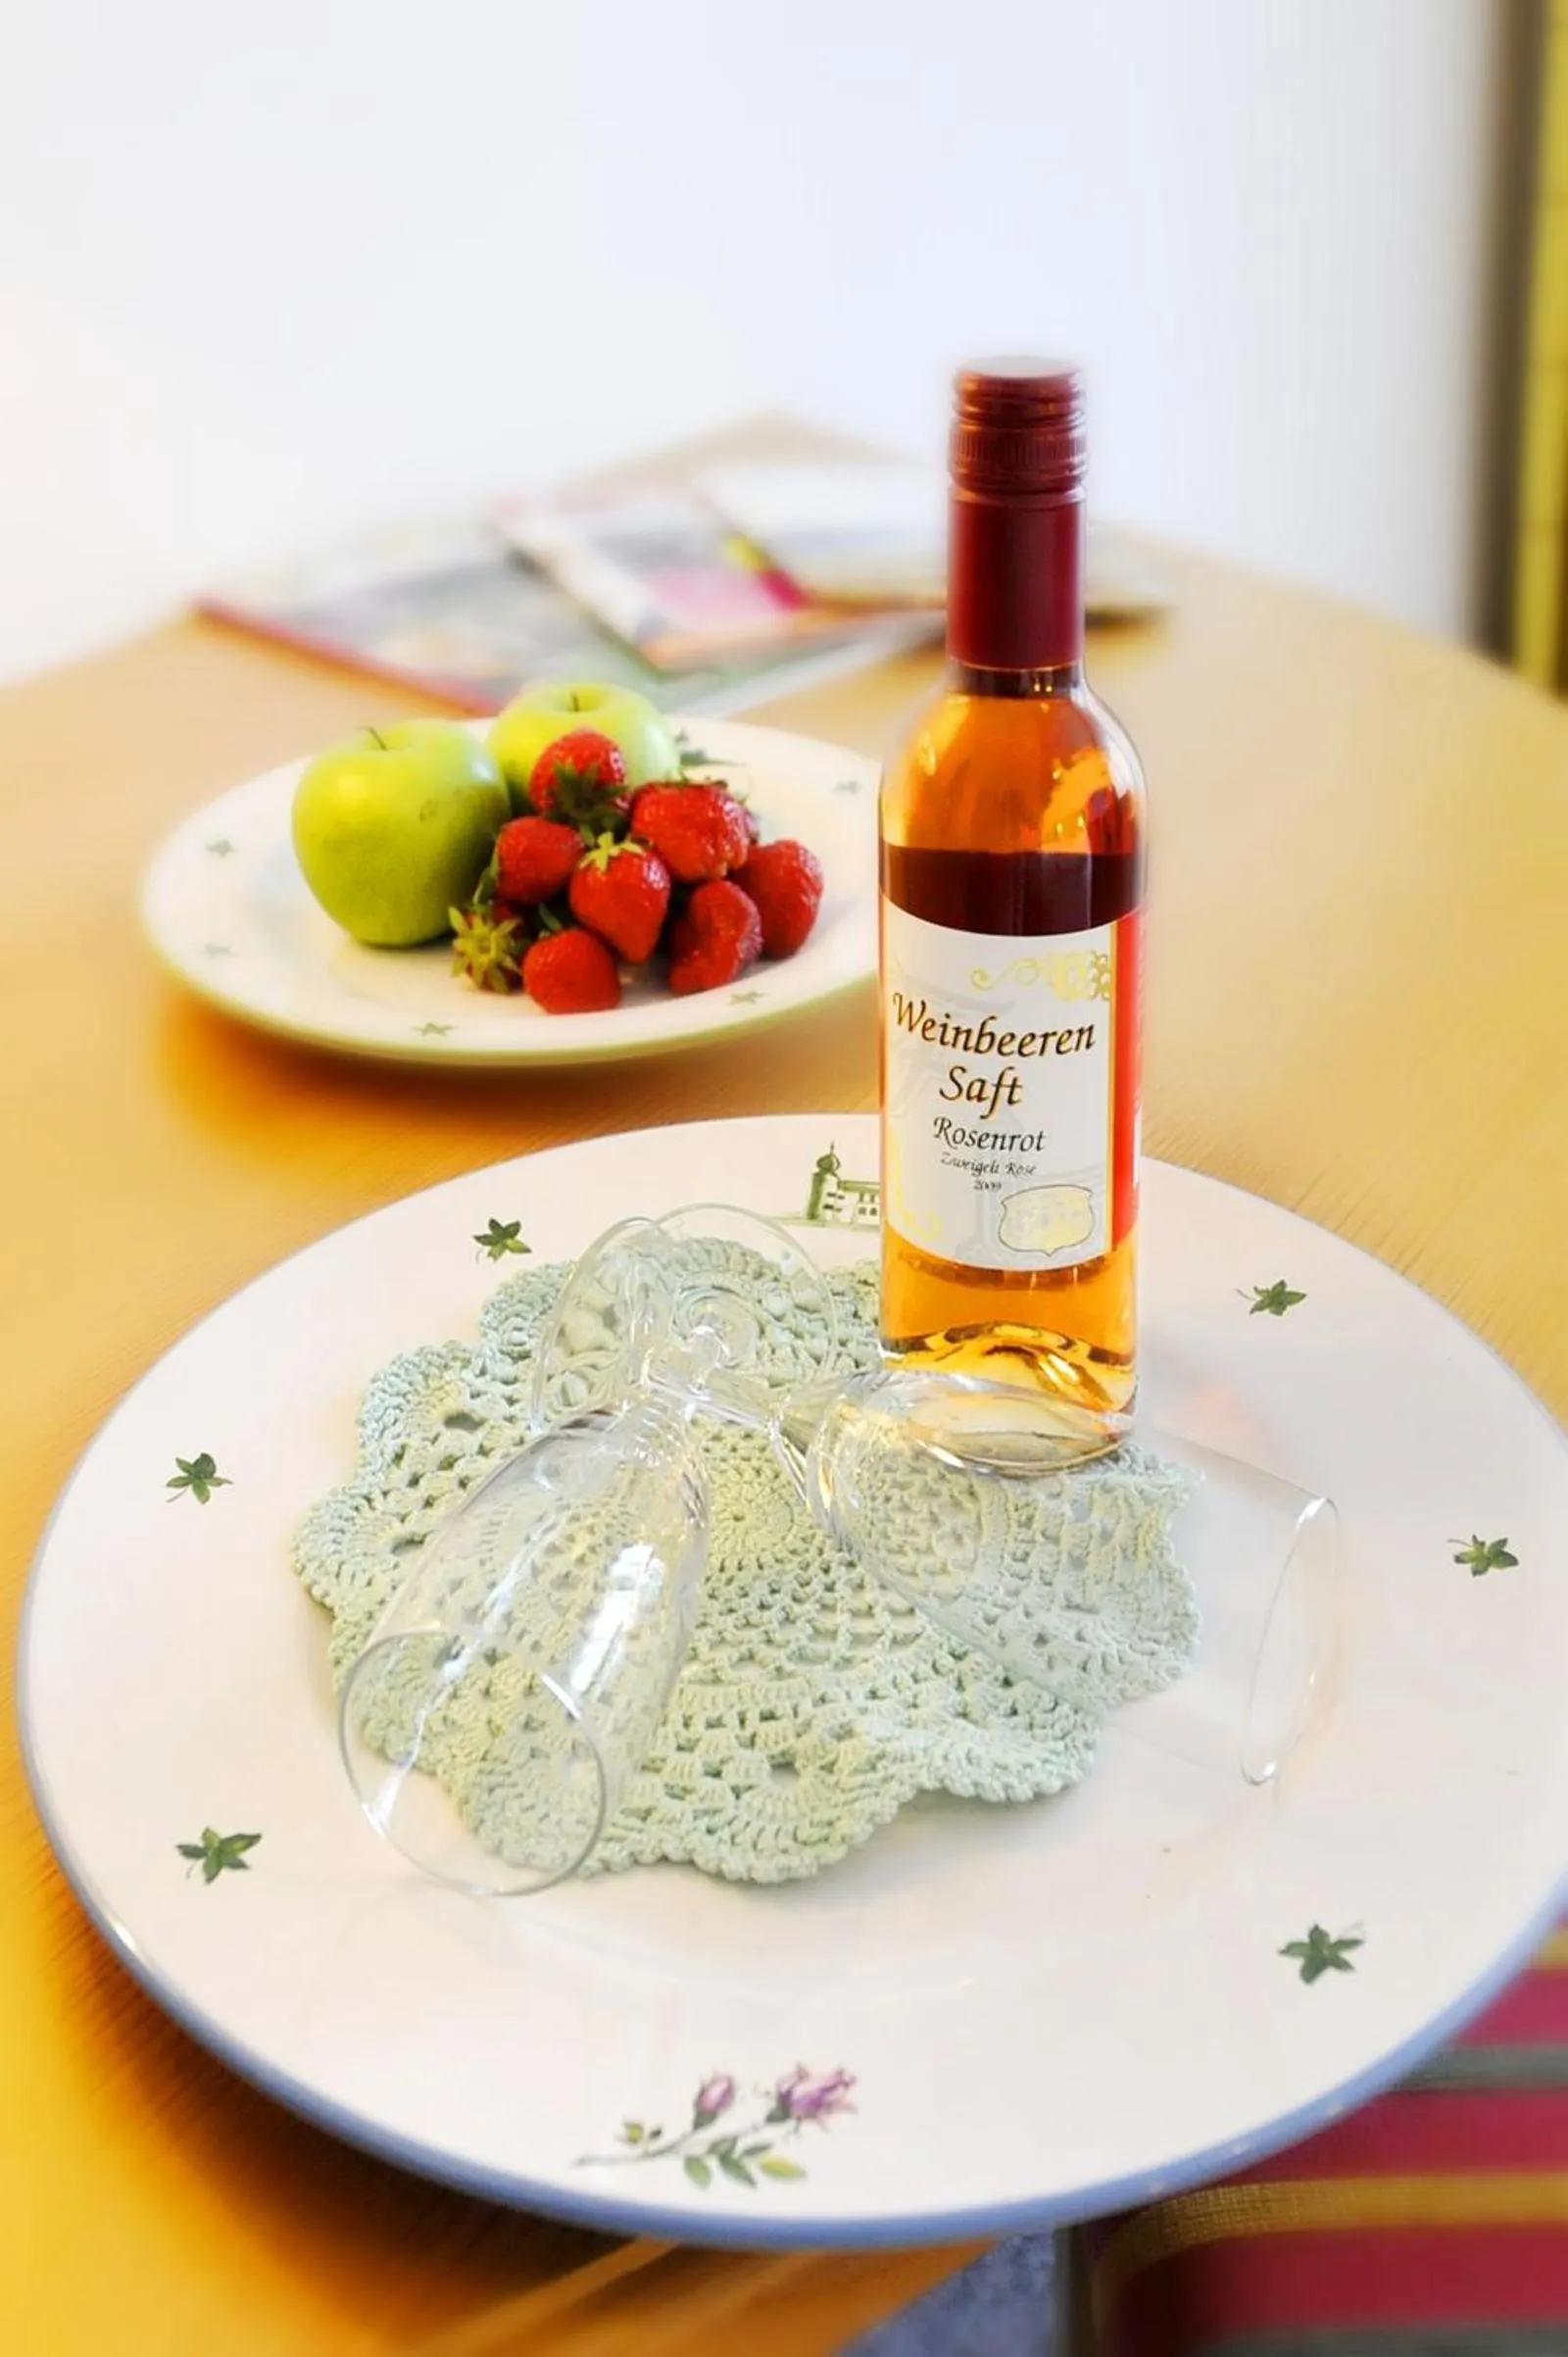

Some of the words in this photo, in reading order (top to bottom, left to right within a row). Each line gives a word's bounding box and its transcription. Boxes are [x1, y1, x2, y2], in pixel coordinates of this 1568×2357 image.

[893, 992, 1096, 1057] Weinbeeren
[939, 1065, 1023, 1119] Saft
[933, 1116, 1046, 1152] Rosenrot
